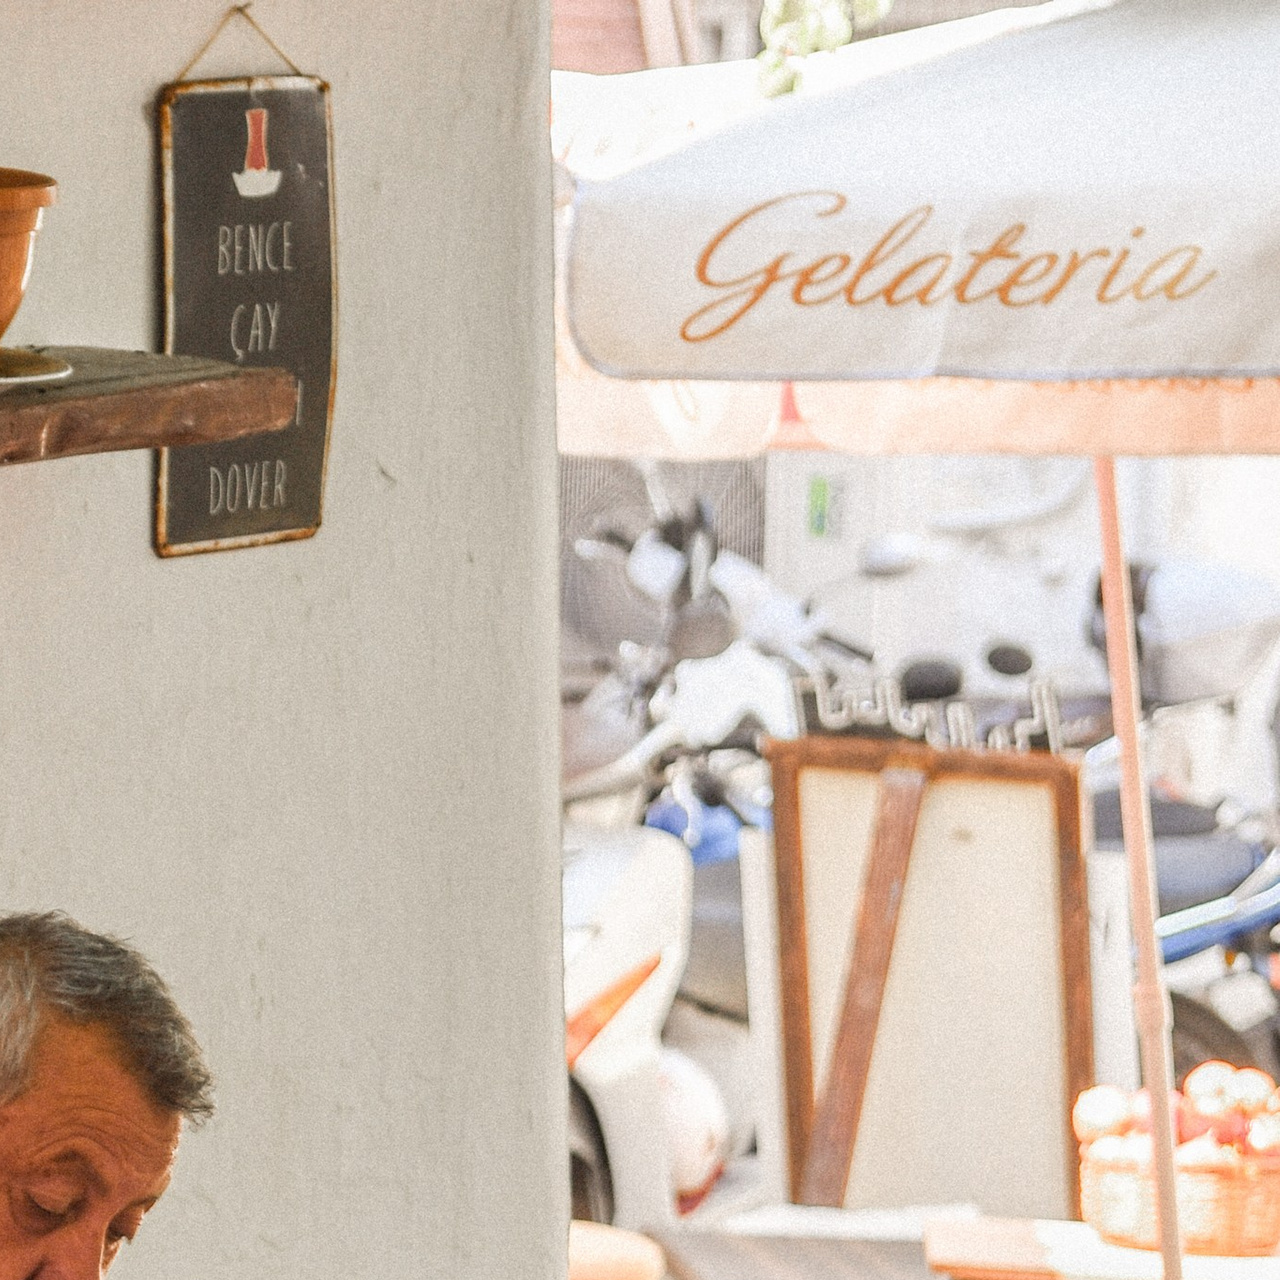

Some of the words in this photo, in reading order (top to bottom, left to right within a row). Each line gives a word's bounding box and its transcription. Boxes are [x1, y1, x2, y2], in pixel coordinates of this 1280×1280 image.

[218, 222, 294, 274] BENCE
[679, 191, 1218, 343] Gelateria
[231, 303, 280, 361] ÇAY
